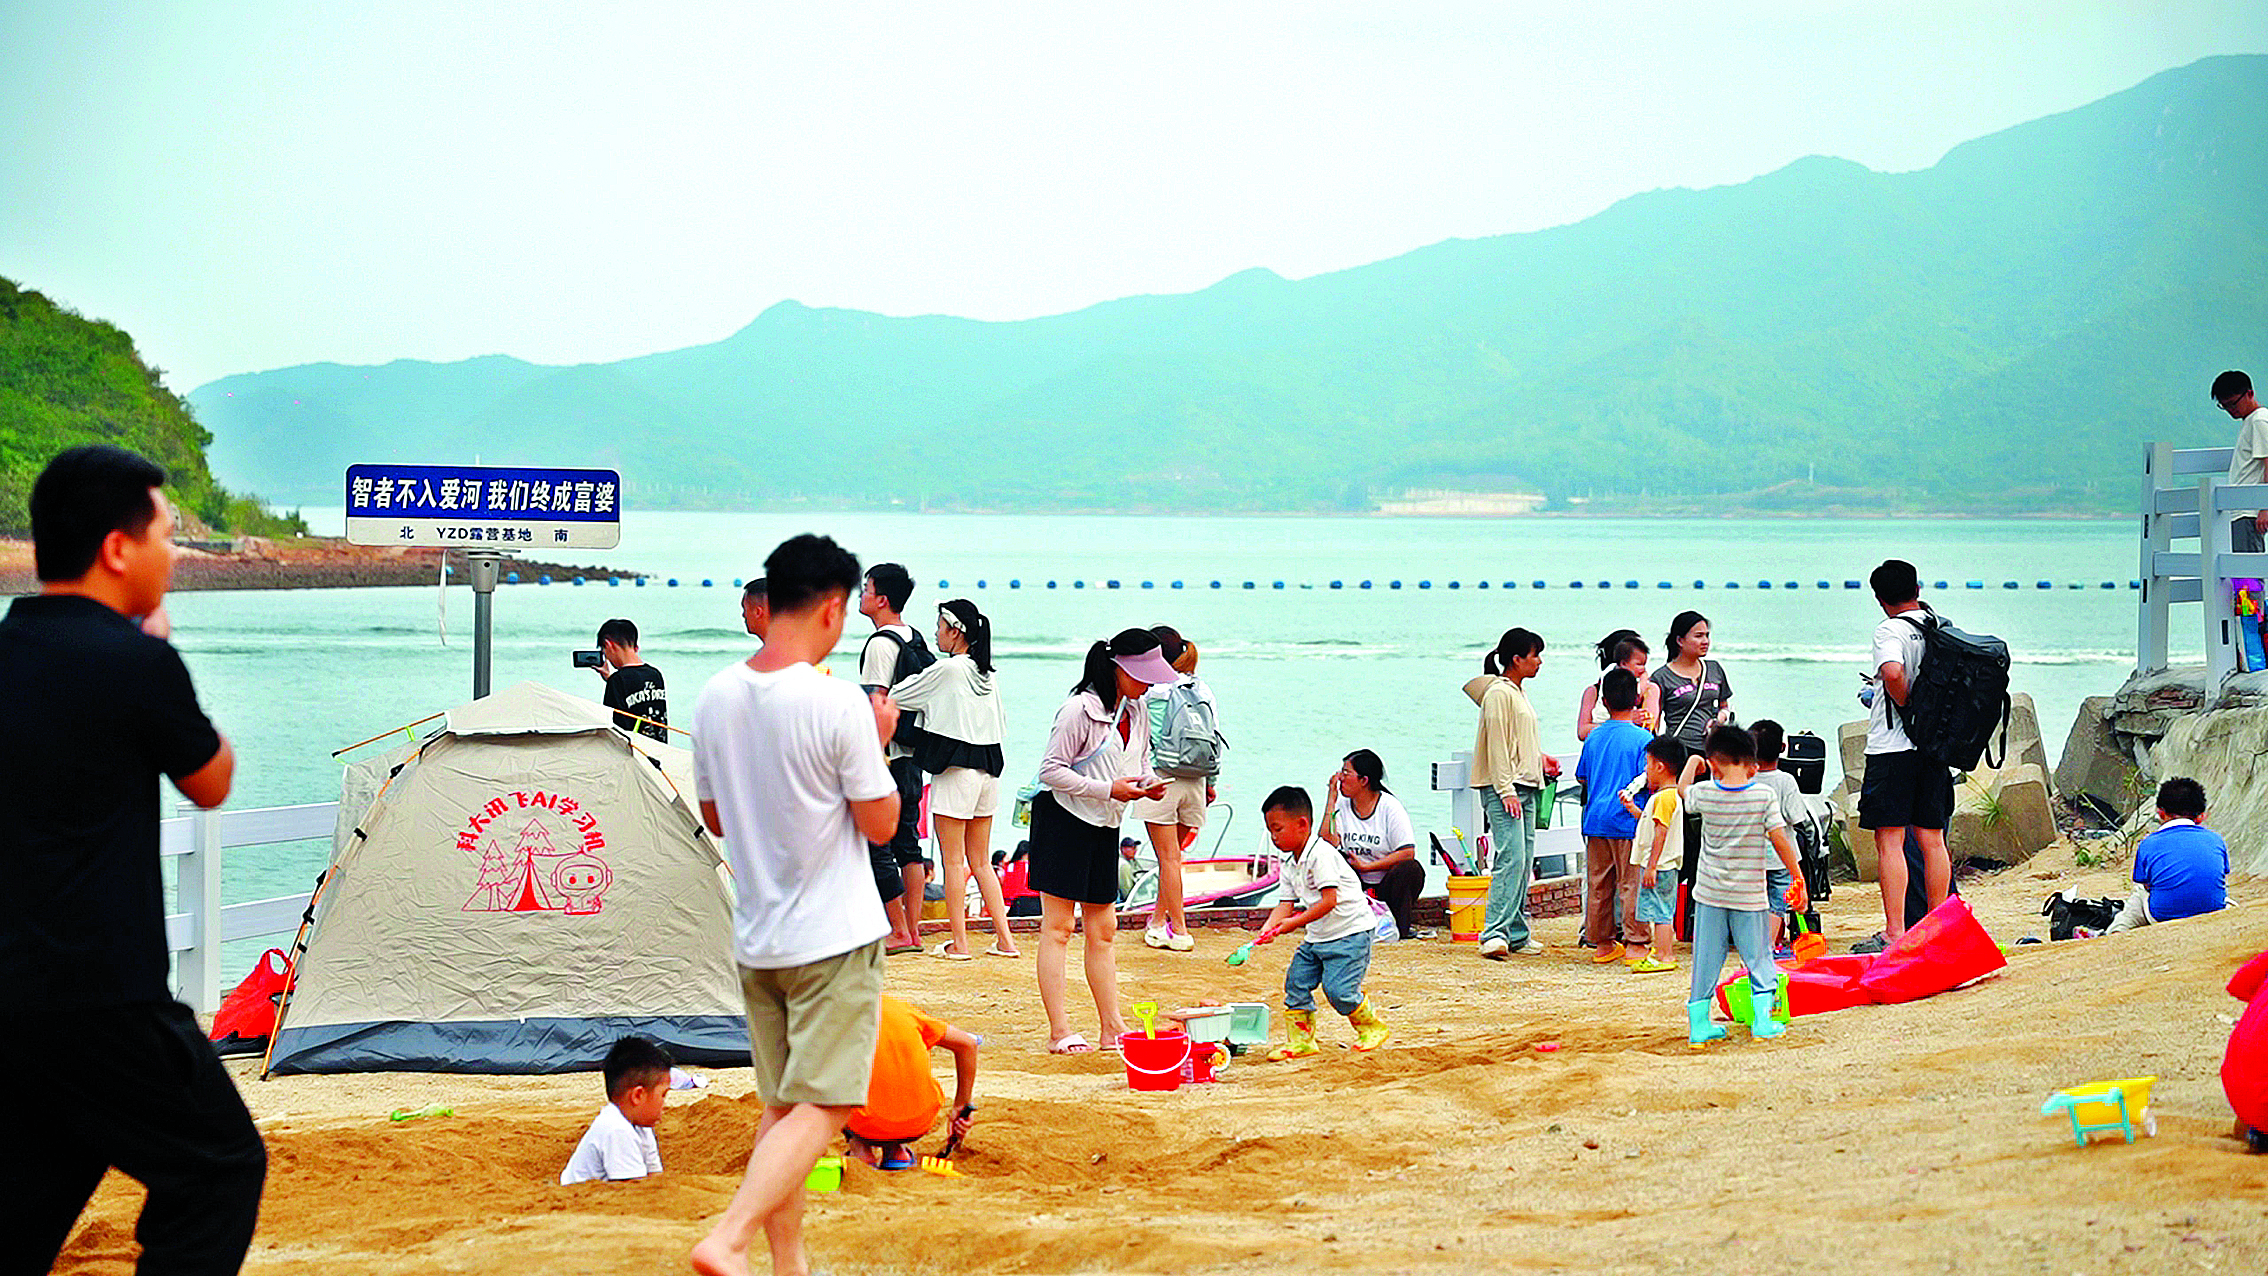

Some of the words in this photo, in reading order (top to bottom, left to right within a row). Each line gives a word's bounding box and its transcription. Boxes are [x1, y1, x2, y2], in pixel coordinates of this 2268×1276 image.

[352, 476, 482, 510] 智者不入爱河
[488, 479, 616, 513] 我们终成富婆
[399, 526, 414, 540] 北
[436, 527, 533, 542] YZD露营基地
[554, 528, 569, 542] 南
[456, 791, 605, 852] 科大讯飞AI学习机
